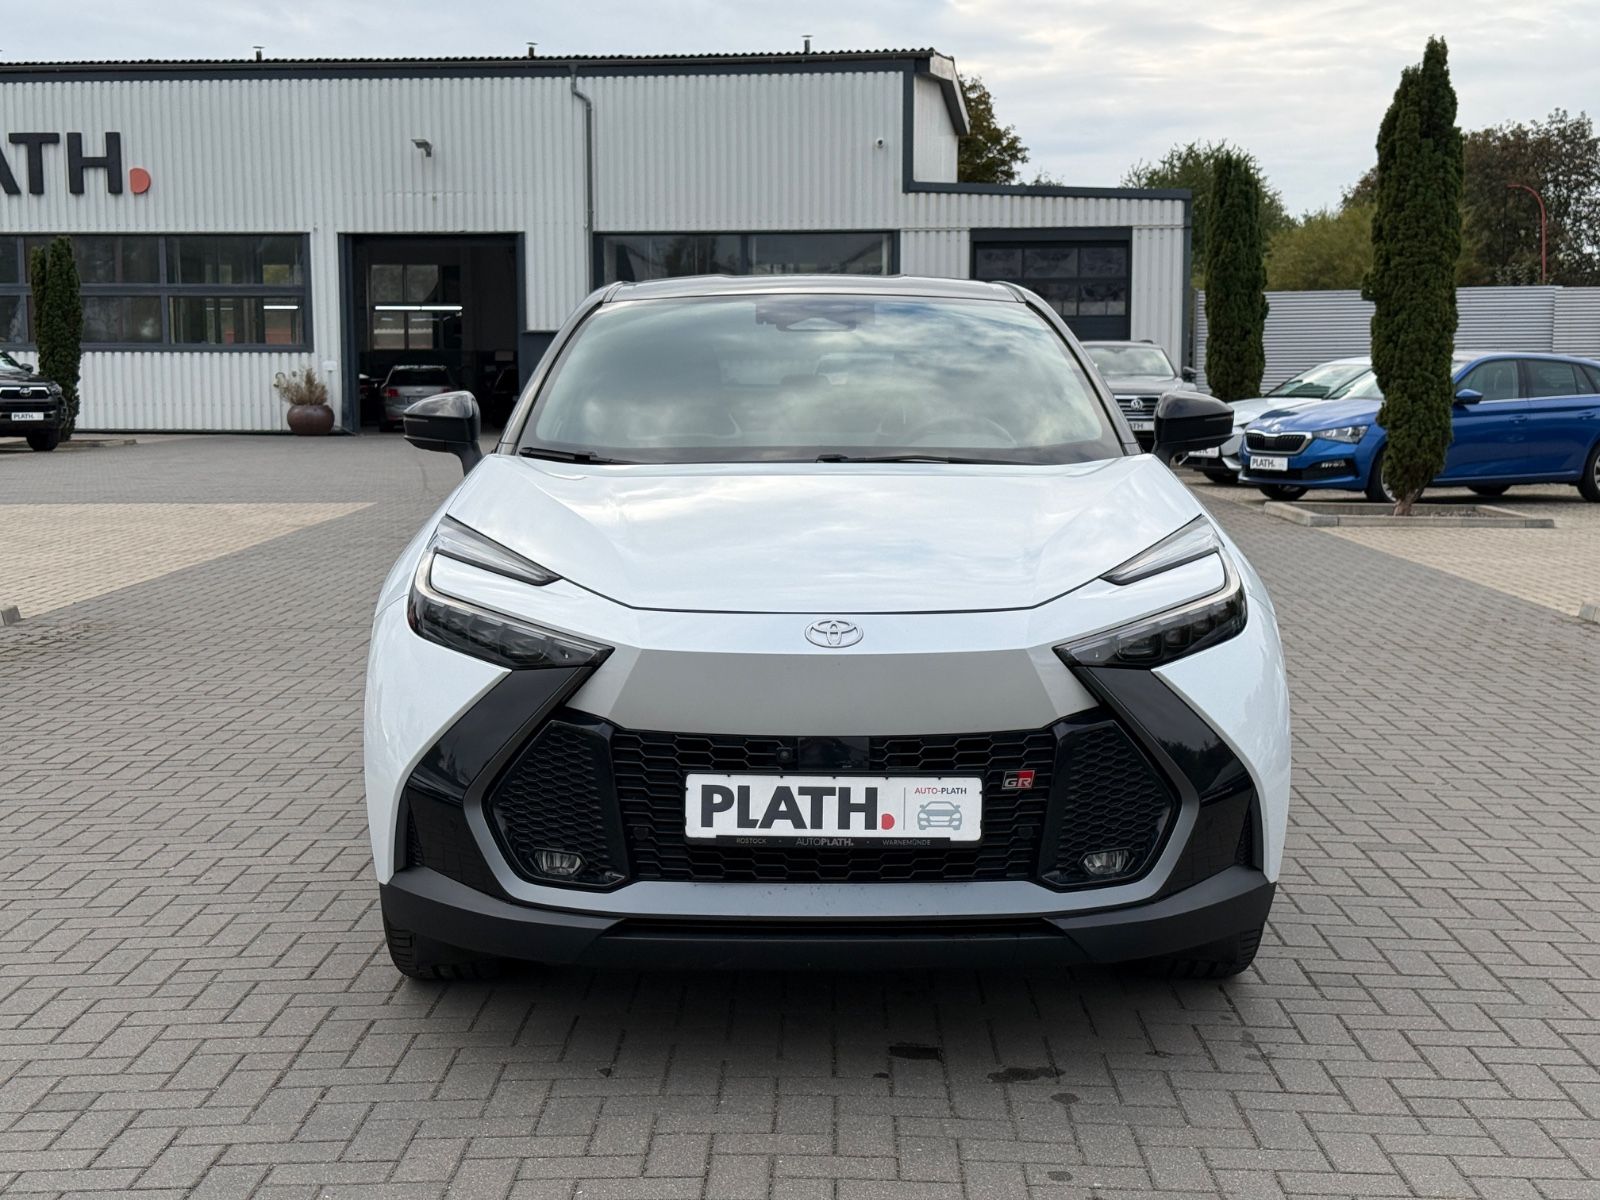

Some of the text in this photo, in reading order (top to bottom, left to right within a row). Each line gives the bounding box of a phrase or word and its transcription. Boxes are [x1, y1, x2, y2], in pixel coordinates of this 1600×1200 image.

[1004, 777, 1031, 788] GR
[914, 787, 967, 795] AUTO-PLATH
[736, 837, 767, 845] ROSTOCK
[882, 838, 931, 847] WARNEMÜNDE
